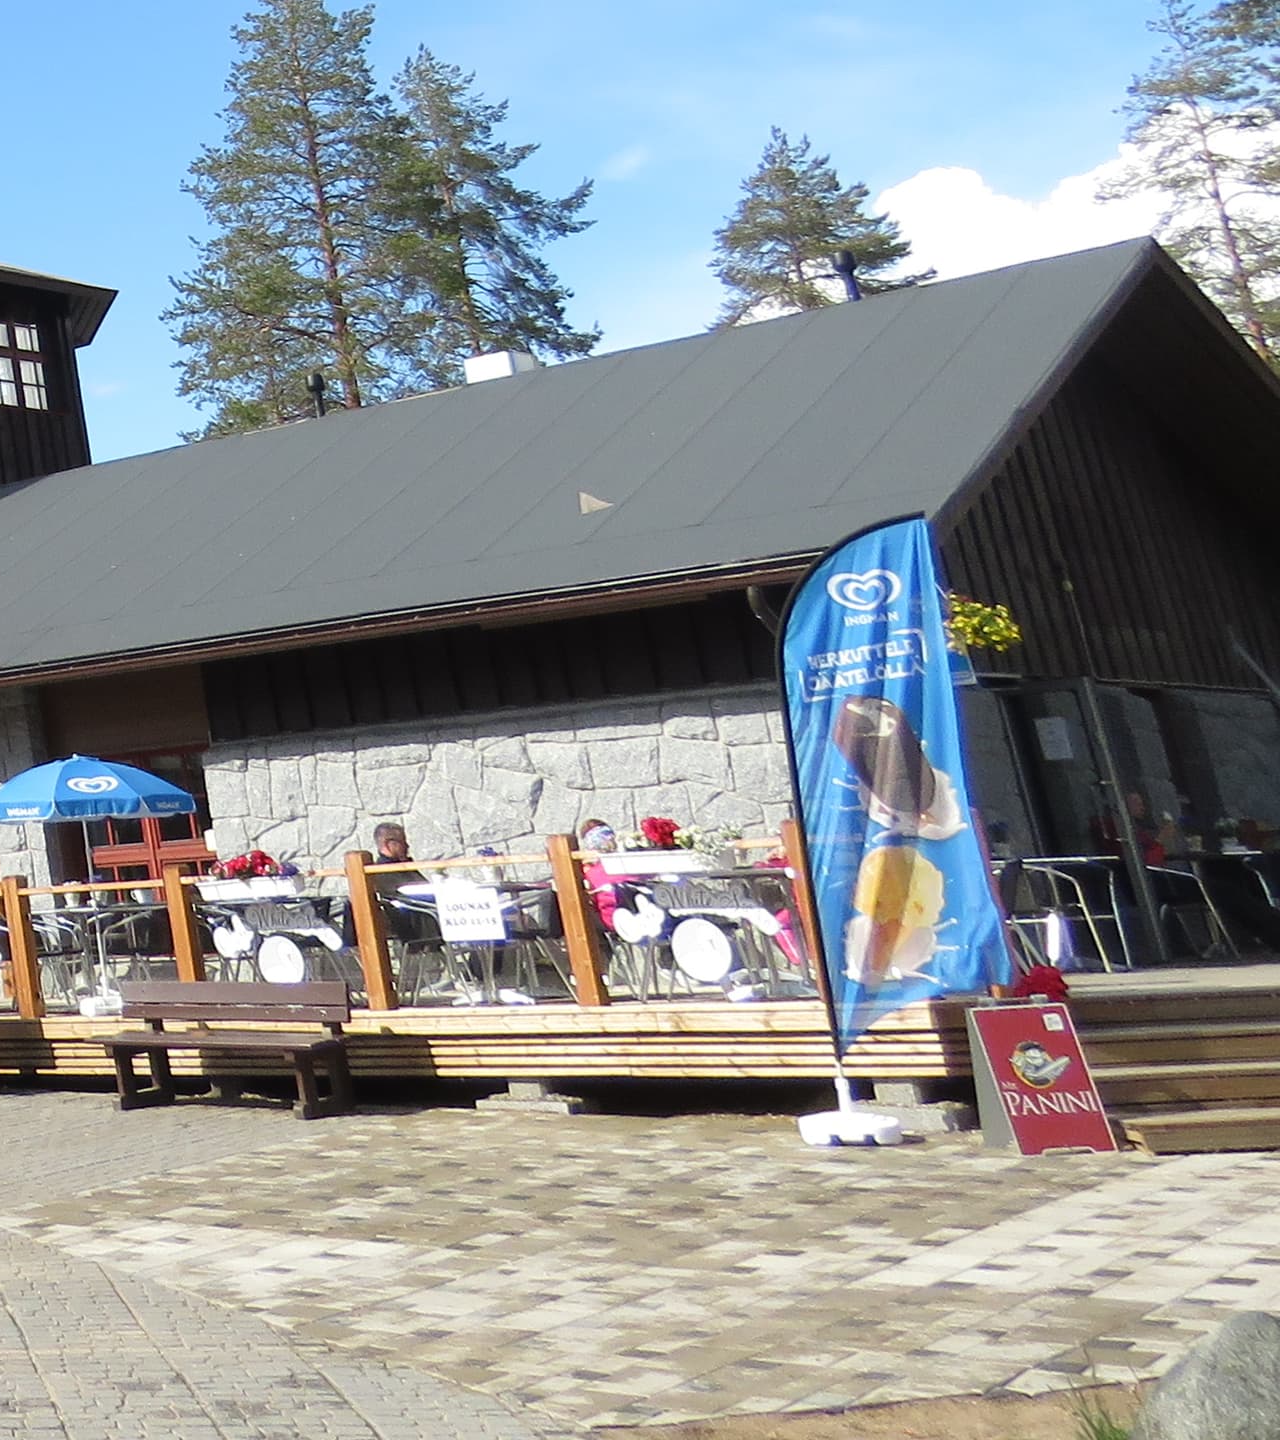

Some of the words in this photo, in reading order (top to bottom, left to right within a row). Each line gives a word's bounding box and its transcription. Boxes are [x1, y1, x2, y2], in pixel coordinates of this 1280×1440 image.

[844, 611, 899, 627] INGMAN
[445, 901, 491, 912] LOUNAS
[1002, 1091, 1099, 1116] PANINI
